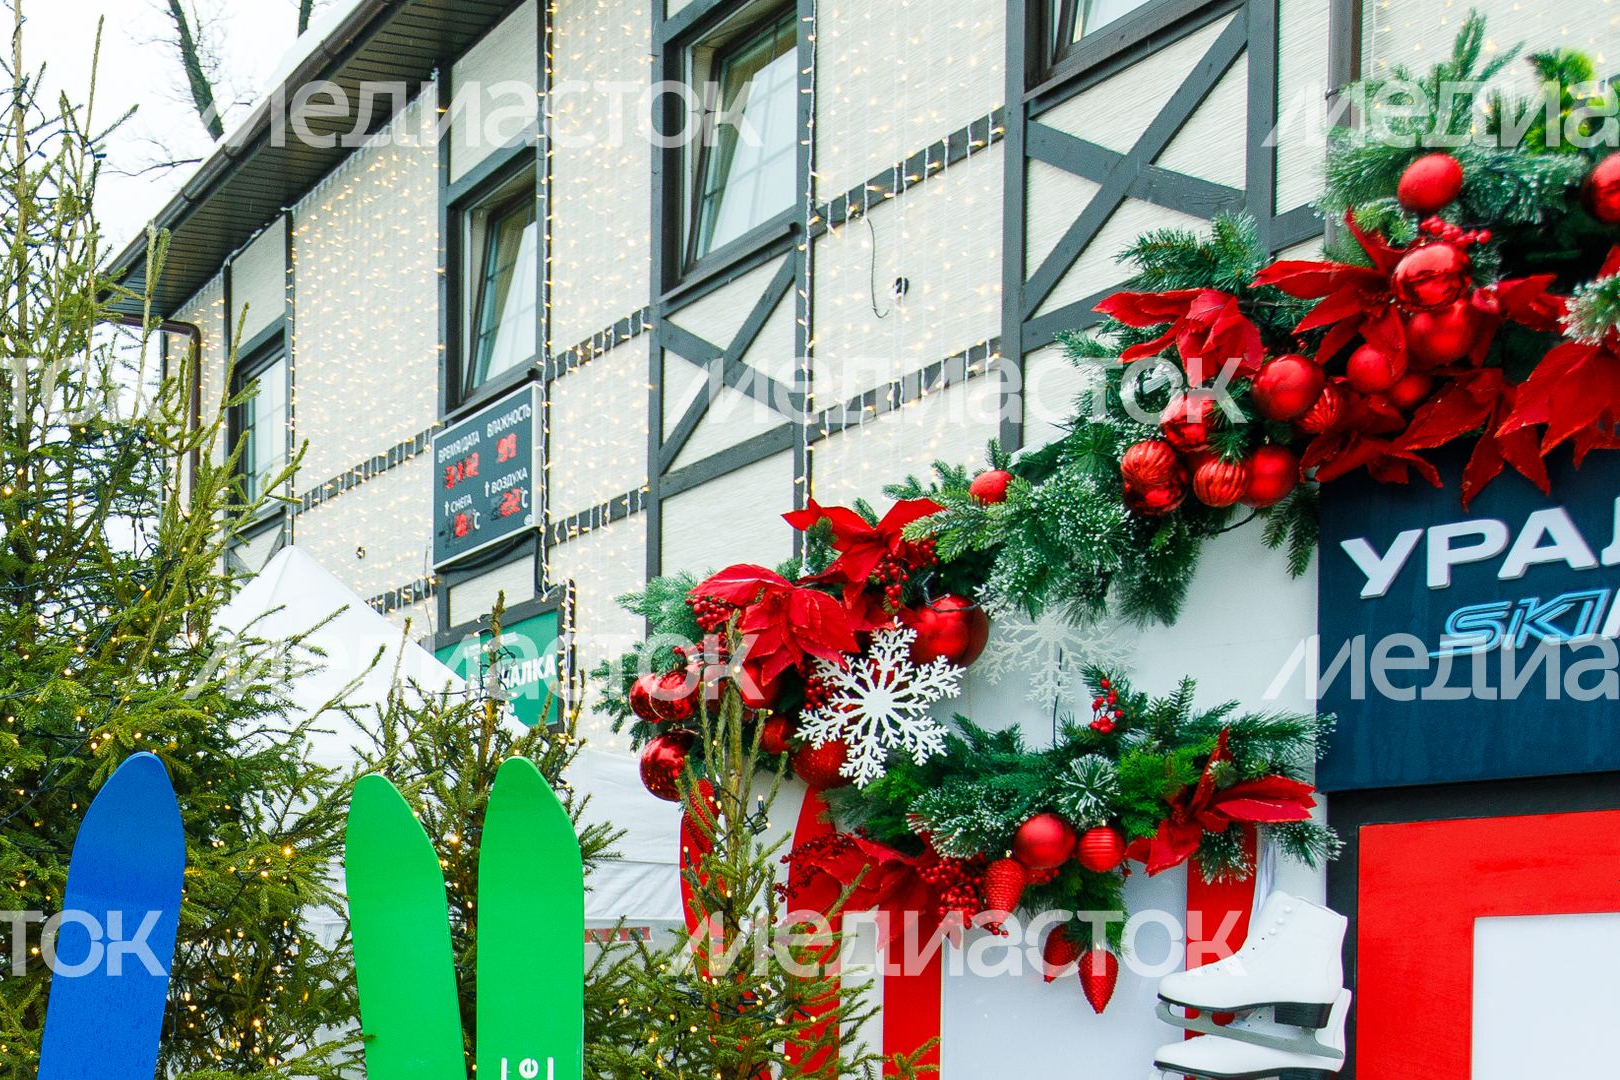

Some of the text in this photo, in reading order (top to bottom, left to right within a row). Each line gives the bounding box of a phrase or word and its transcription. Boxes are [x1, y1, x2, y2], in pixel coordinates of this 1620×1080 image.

[486, 403, 532, 438] ВЛАЖНОСТЬ
[491, 467, 529, 495] ВОЗДУХА
[449, 494, 473, 514] СНЕГА
